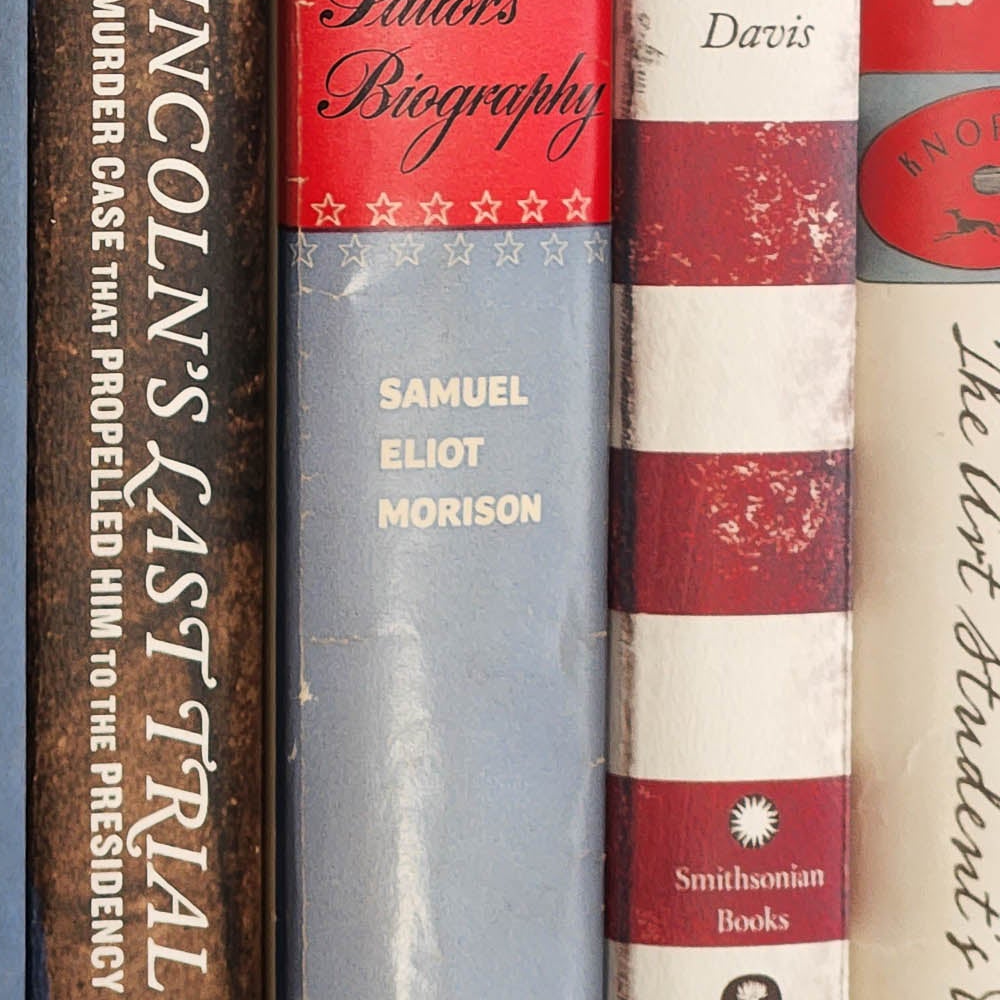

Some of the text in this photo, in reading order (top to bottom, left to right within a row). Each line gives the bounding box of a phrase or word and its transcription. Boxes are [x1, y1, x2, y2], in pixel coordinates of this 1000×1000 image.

[700, 12, 815, 50] Davis
[317, 46, 606, 175] Biography
[90, 156, 125, 251] CASE
[90, 261, 118, 338] THAT
[379, 375, 529, 410] SAMUEL
[90, 348, 124, 558] PROPELLED
[380, 437, 485, 469] ELIOT
[378, 493, 542, 528] MORISON
[123, 440, 217, 689] LAST
[90, 568, 123, 639] HIM
[90, 649, 117, 688] TO
[90, 695, 116, 752] THE
[89, 762, 124, 994] PRESIDENCY
[126, 700, 217, 992] TRIAL
[675, 863, 825, 892] Smithsonian
[718, 906, 790, 933] Books
